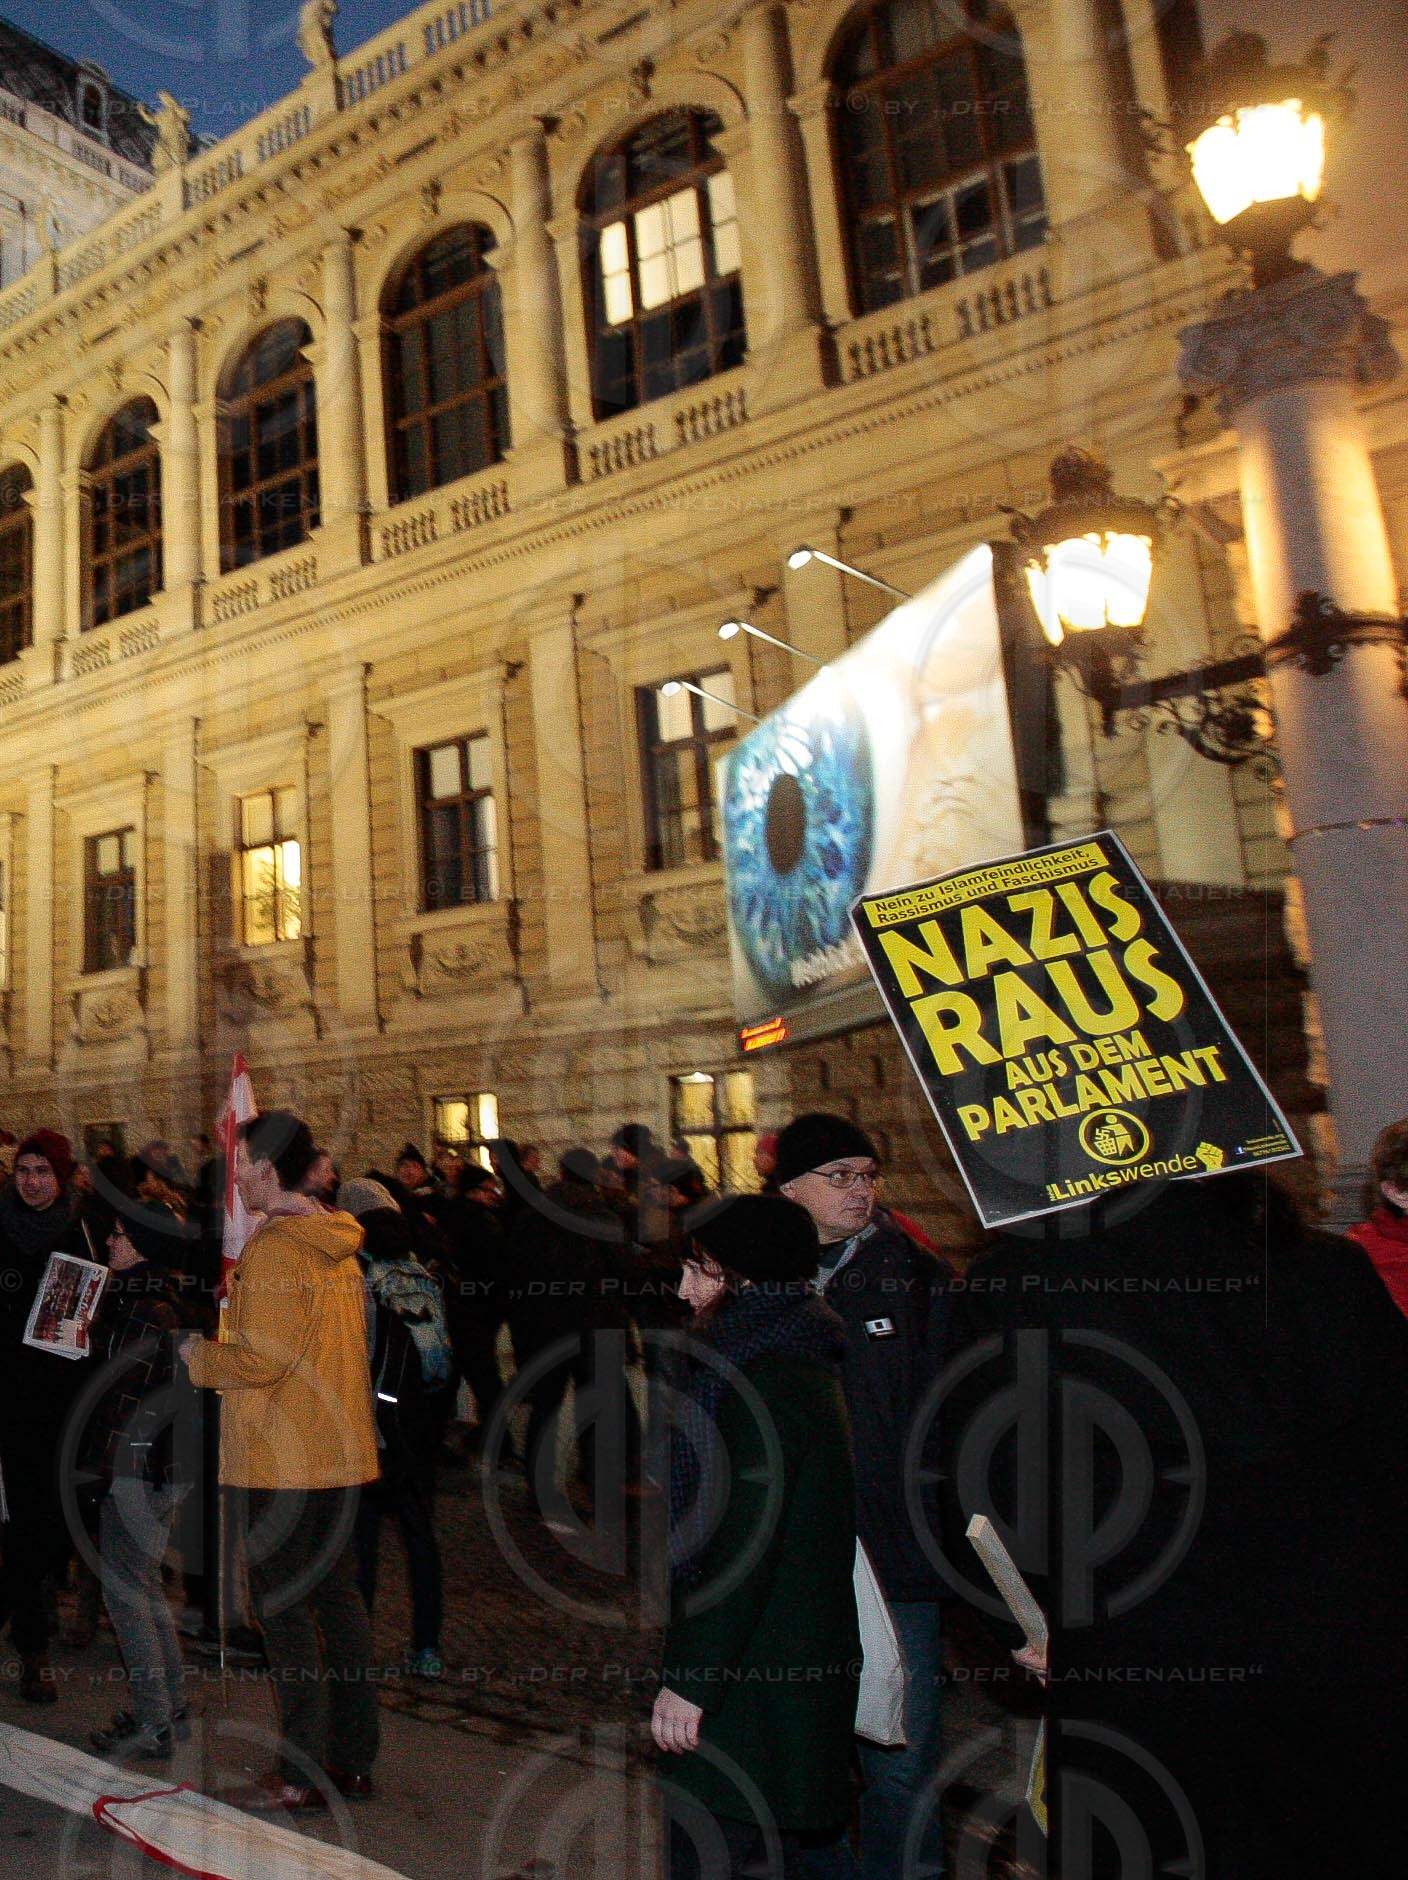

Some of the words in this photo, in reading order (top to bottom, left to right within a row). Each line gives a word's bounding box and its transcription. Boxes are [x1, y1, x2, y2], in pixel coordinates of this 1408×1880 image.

[875, 898, 913, 913] Nein
[917, 891, 936, 906] zu
[939, 849, 1091, 896] Islamfeindlichkeit,
[878, 892, 963, 924] Rassismus
[967, 881, 1000, 898] und
[1004, 858, 1099, 887] Faschismus
[877, 871, 1142, 998] NAZIS
[910, 938, 1184, 1076] RAUS
[1005, 1051, 1069, 1091] AUS
[1068, 1030, 1152, 1072] DEM
[957, 1046, 1226, 1142] PARLAMENT
[1051, 1153, 1197, 1200] Linkswende
